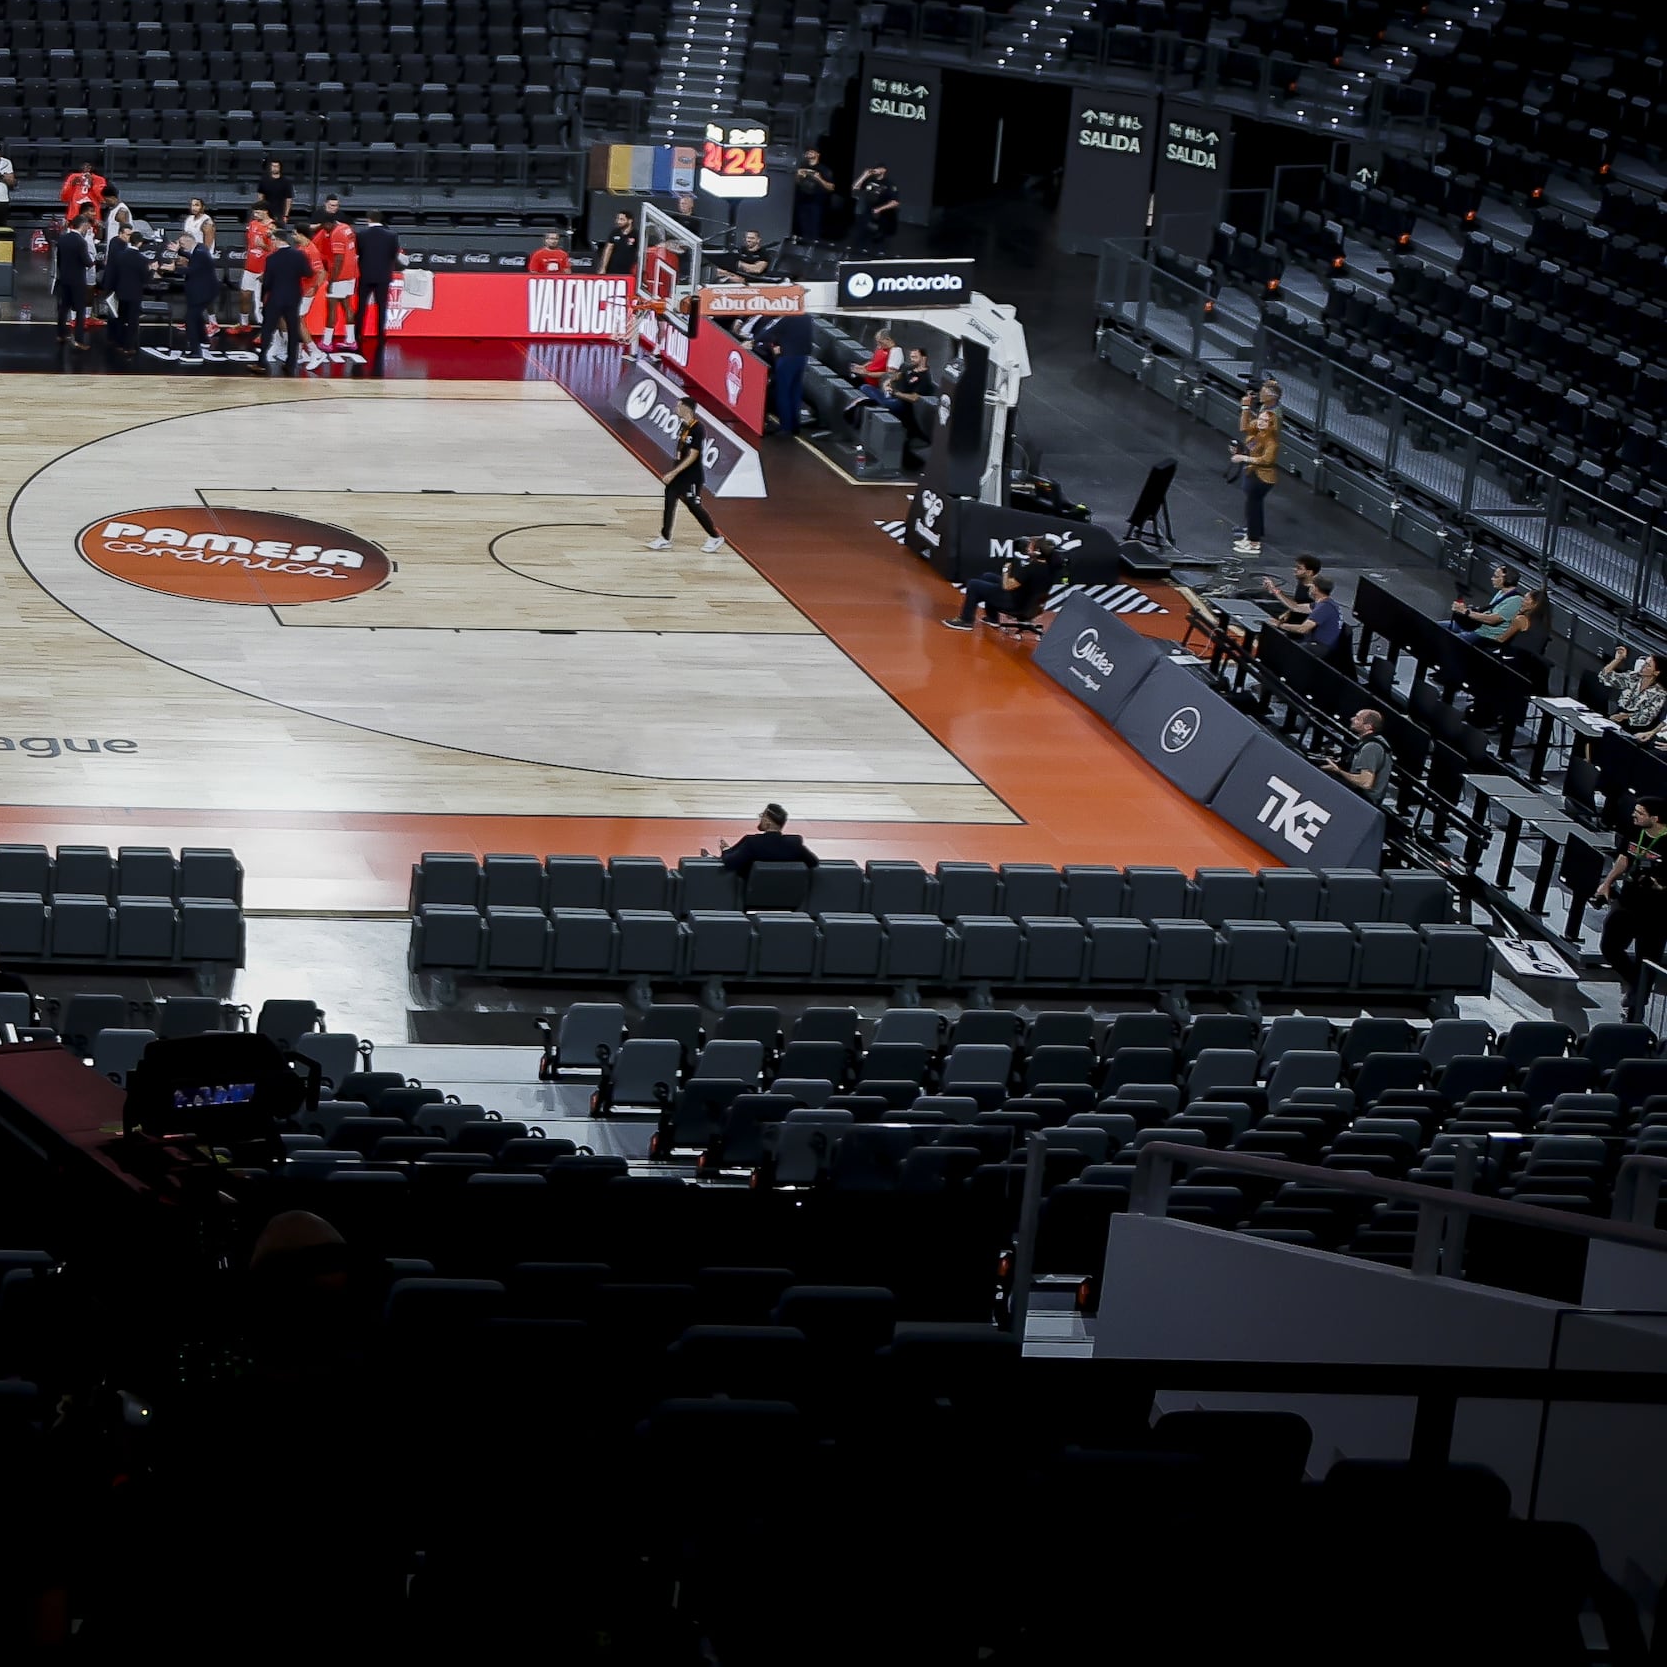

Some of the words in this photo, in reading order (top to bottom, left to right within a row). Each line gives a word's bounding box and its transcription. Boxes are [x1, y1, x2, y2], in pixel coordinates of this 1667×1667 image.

[870, 97, 927, 122] SALIDA
[1079, 129, 1141, 155] SALIDA
[724, 148, 764, 174] 24
[1167, 143, 1217, 171] SALIDA
[877, 274, 963, 292] motorola
[528, 279, 627, 334] VALENCIA
[709, 295, 746, 311] abu
[101, 520, 364, 571] PAMESA
[102, 537, 350, 581] cerámica
[1072, 628, 1115, 677] Midea
[1170, 719, 1192, 740] SH
[1256, 775, 1332, 854] TKE
